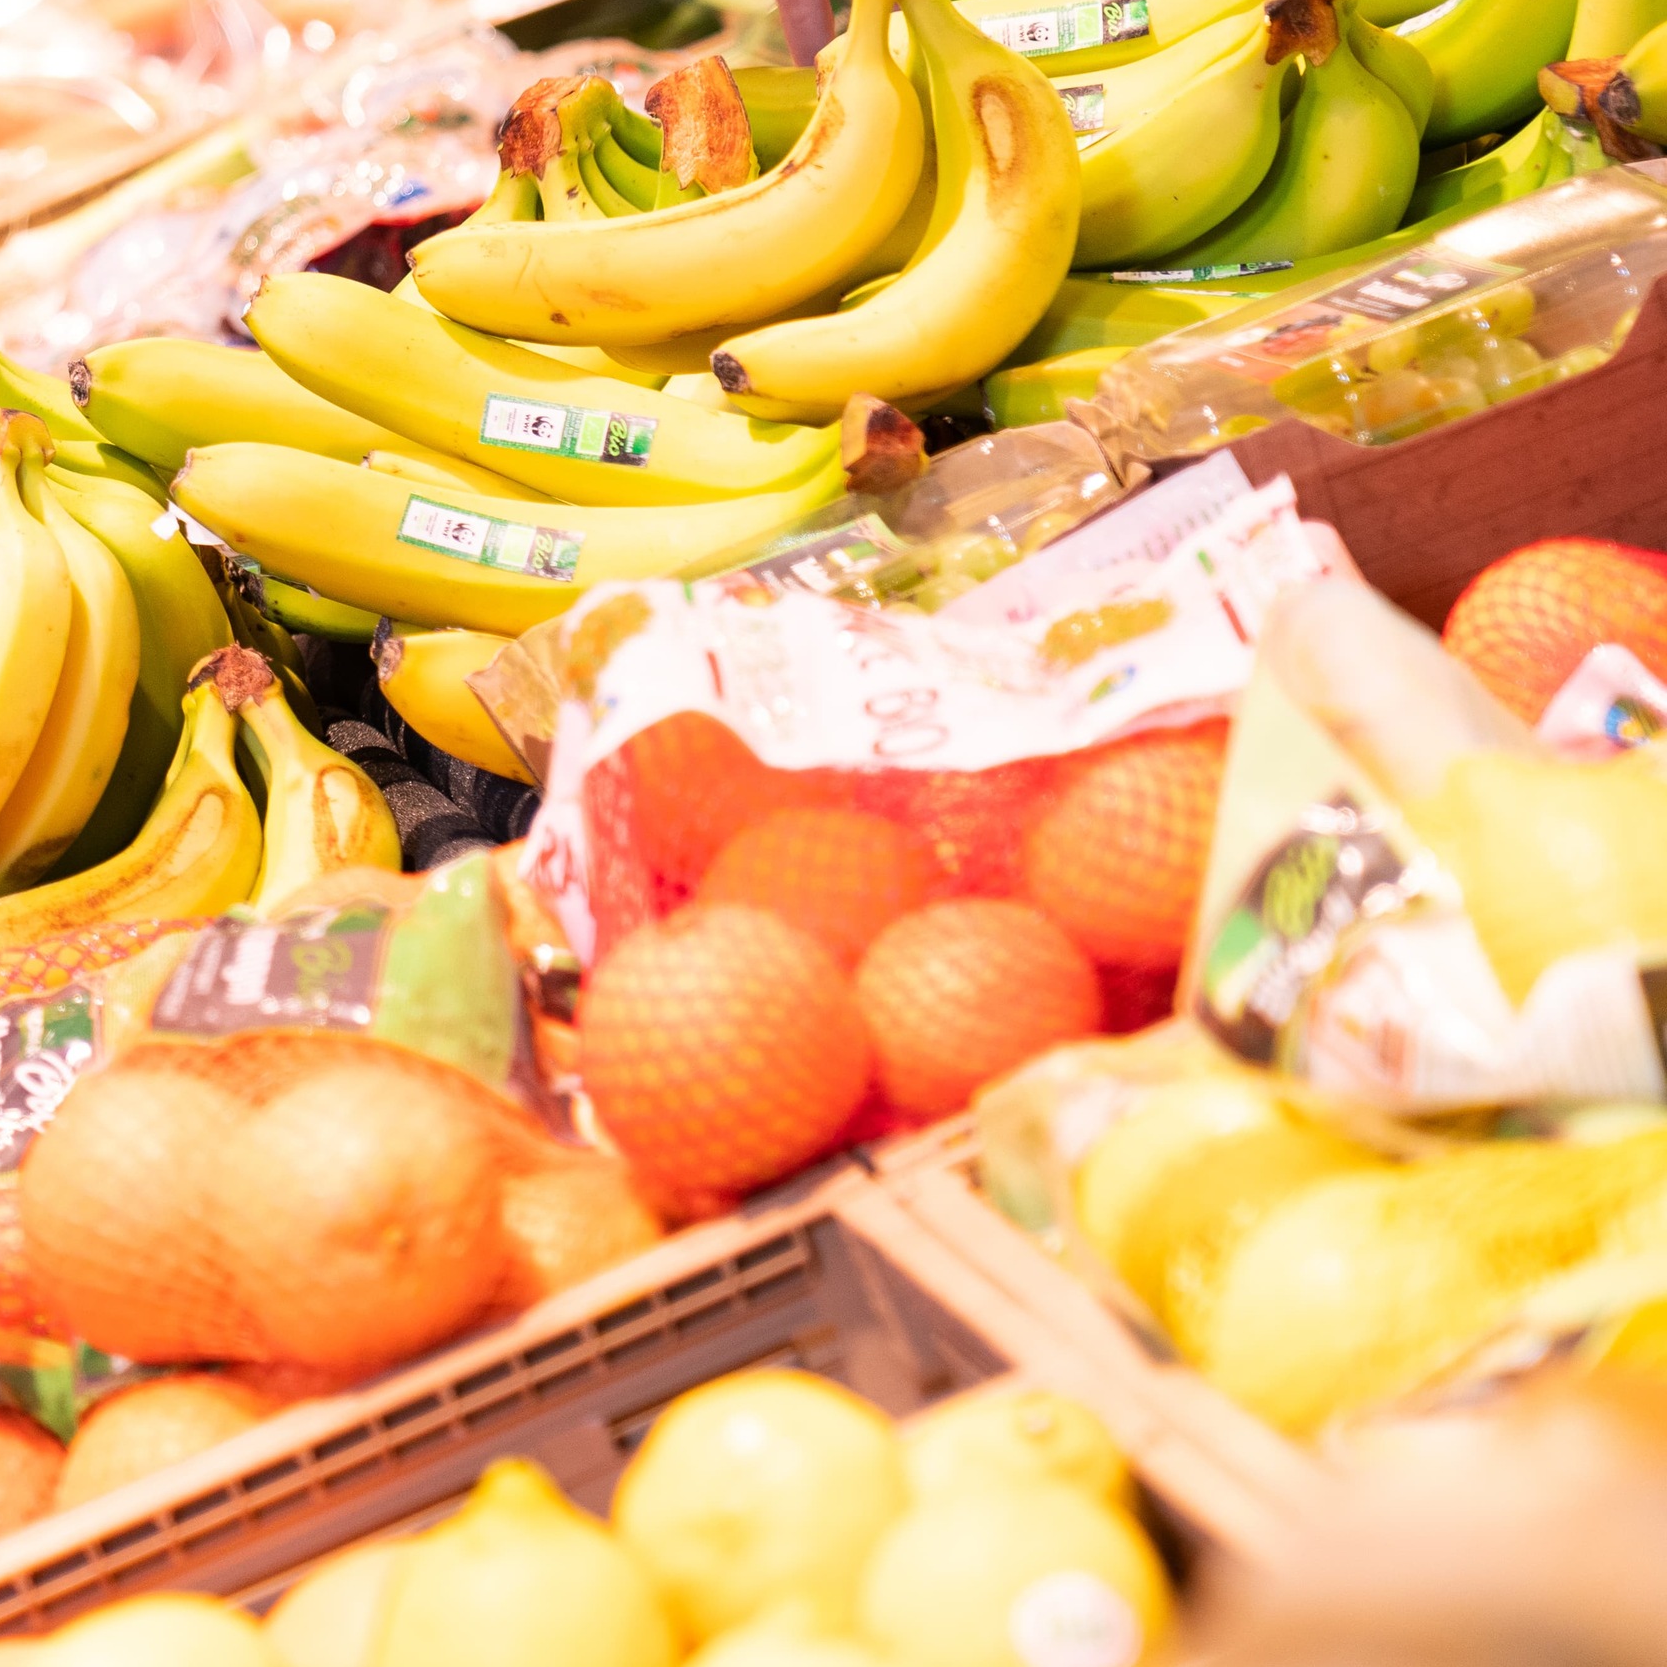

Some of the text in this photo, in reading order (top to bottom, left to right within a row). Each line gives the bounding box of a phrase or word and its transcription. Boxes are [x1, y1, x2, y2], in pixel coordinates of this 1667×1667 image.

[1103, 2, 1123, 37] Bio
[608, 418, 628, 457] Bio
[532, 533, 554, 570] Bio
